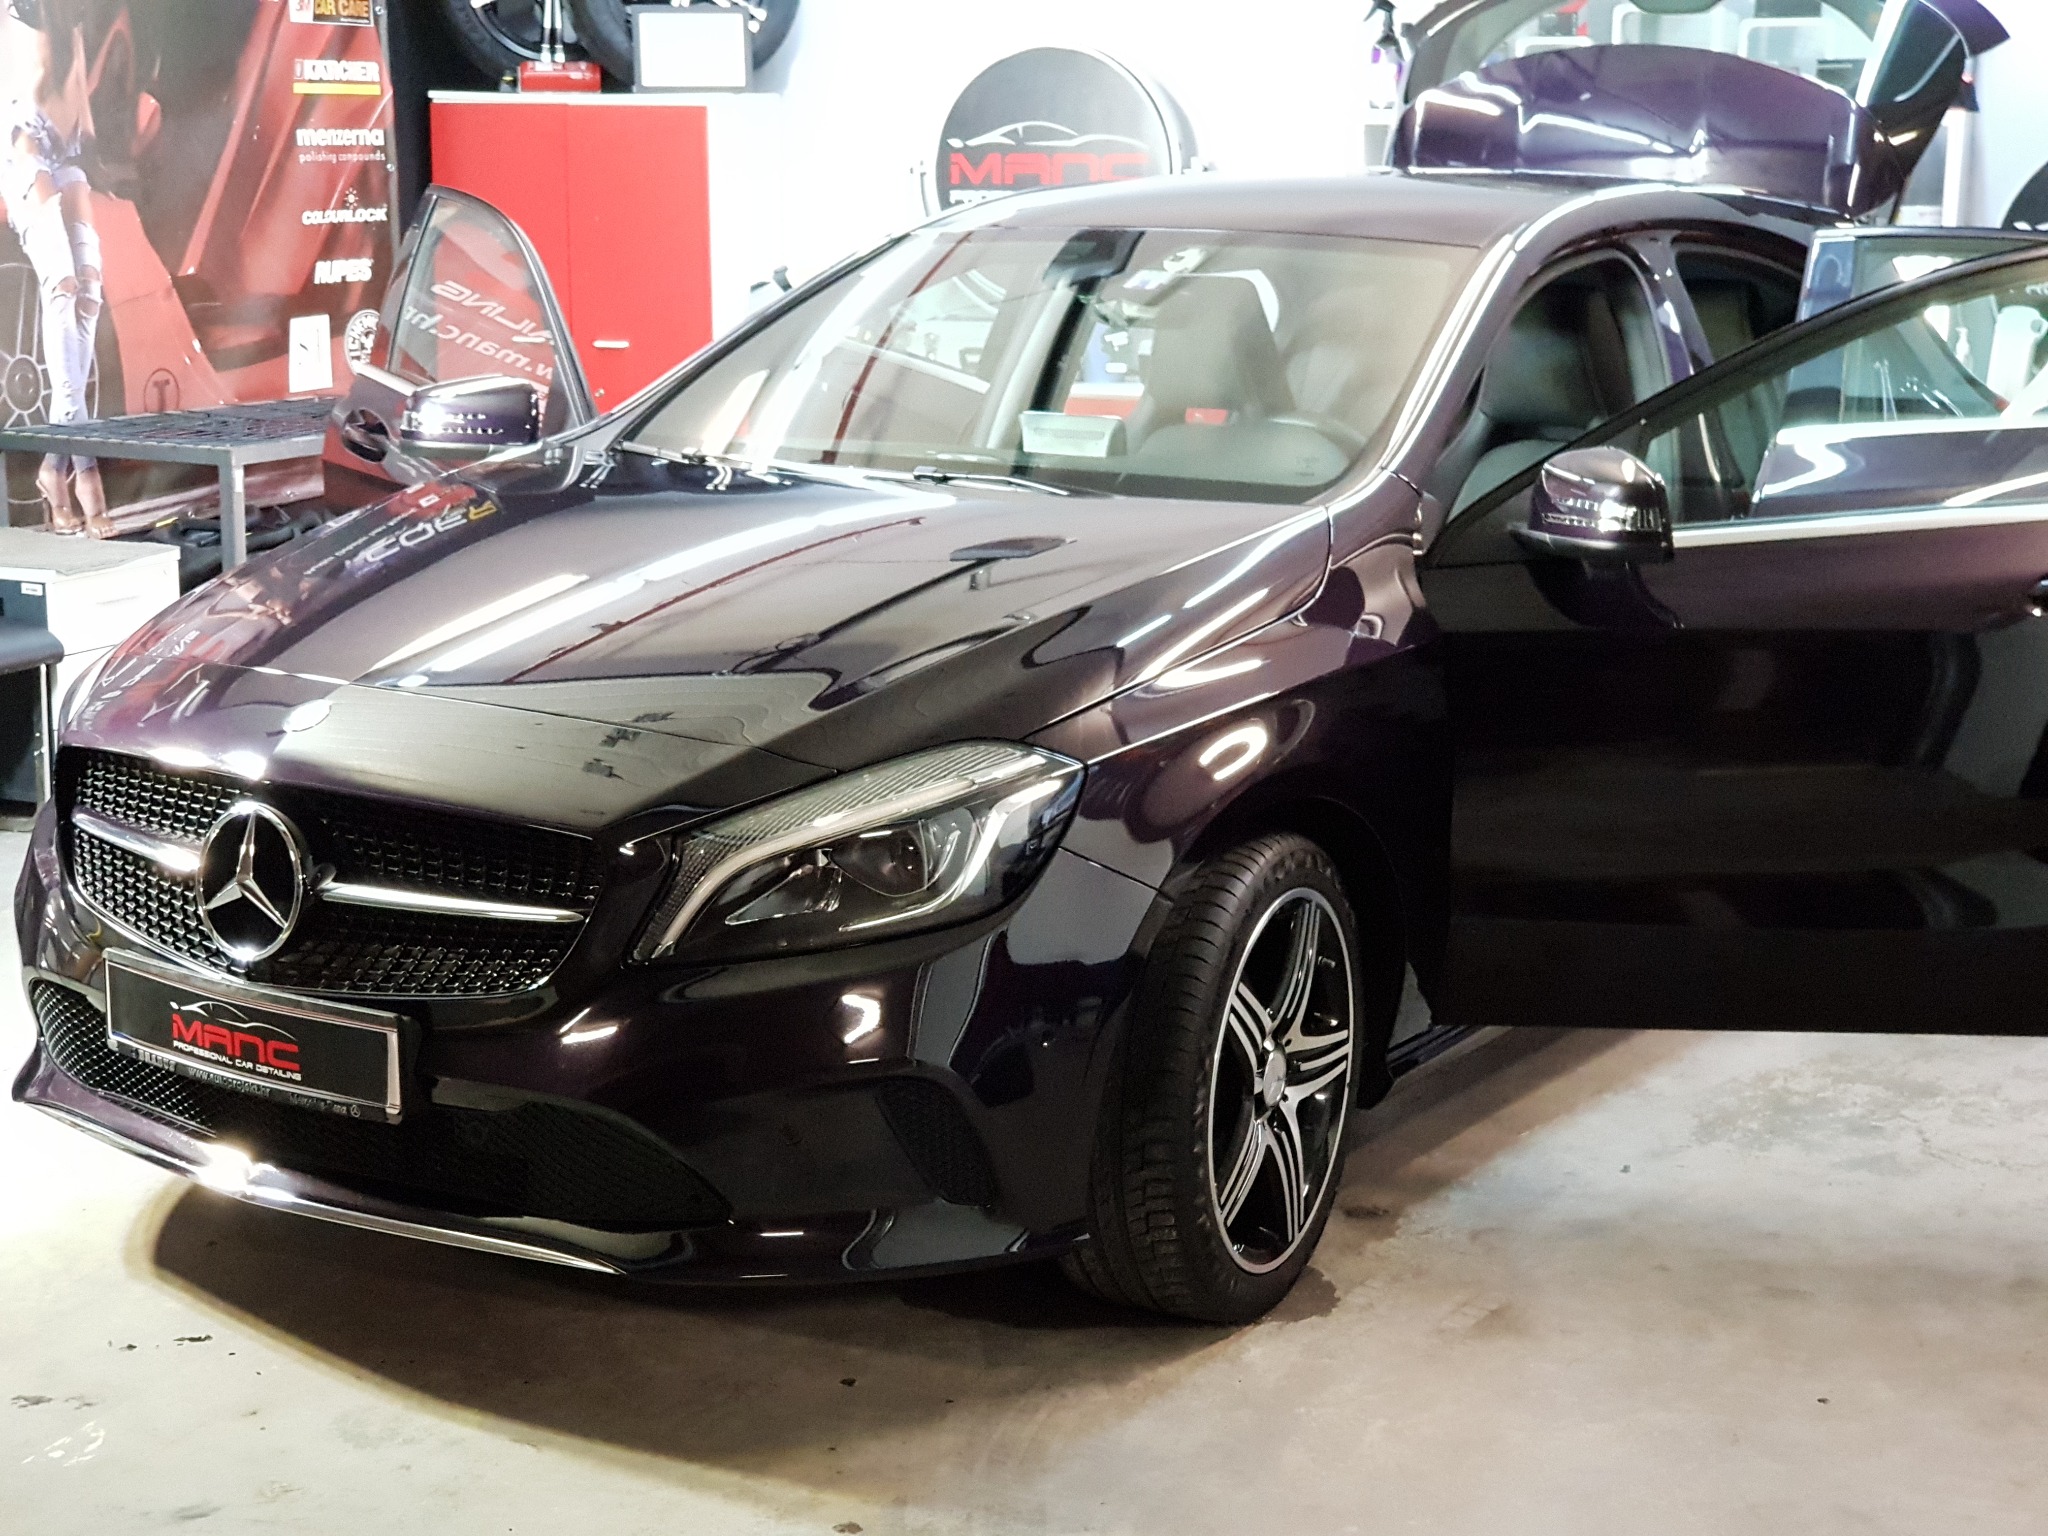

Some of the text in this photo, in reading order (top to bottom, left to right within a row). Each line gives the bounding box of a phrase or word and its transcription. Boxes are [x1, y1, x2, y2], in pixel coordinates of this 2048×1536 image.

[295, 129, 386, 147] menzerna
[302, 208, 388, 225] COLOURLOCK
[313, 258, 373, 285] RUPES
[172, 1040, 302, 1082] PROFESSIONAL CAR DETAILING
